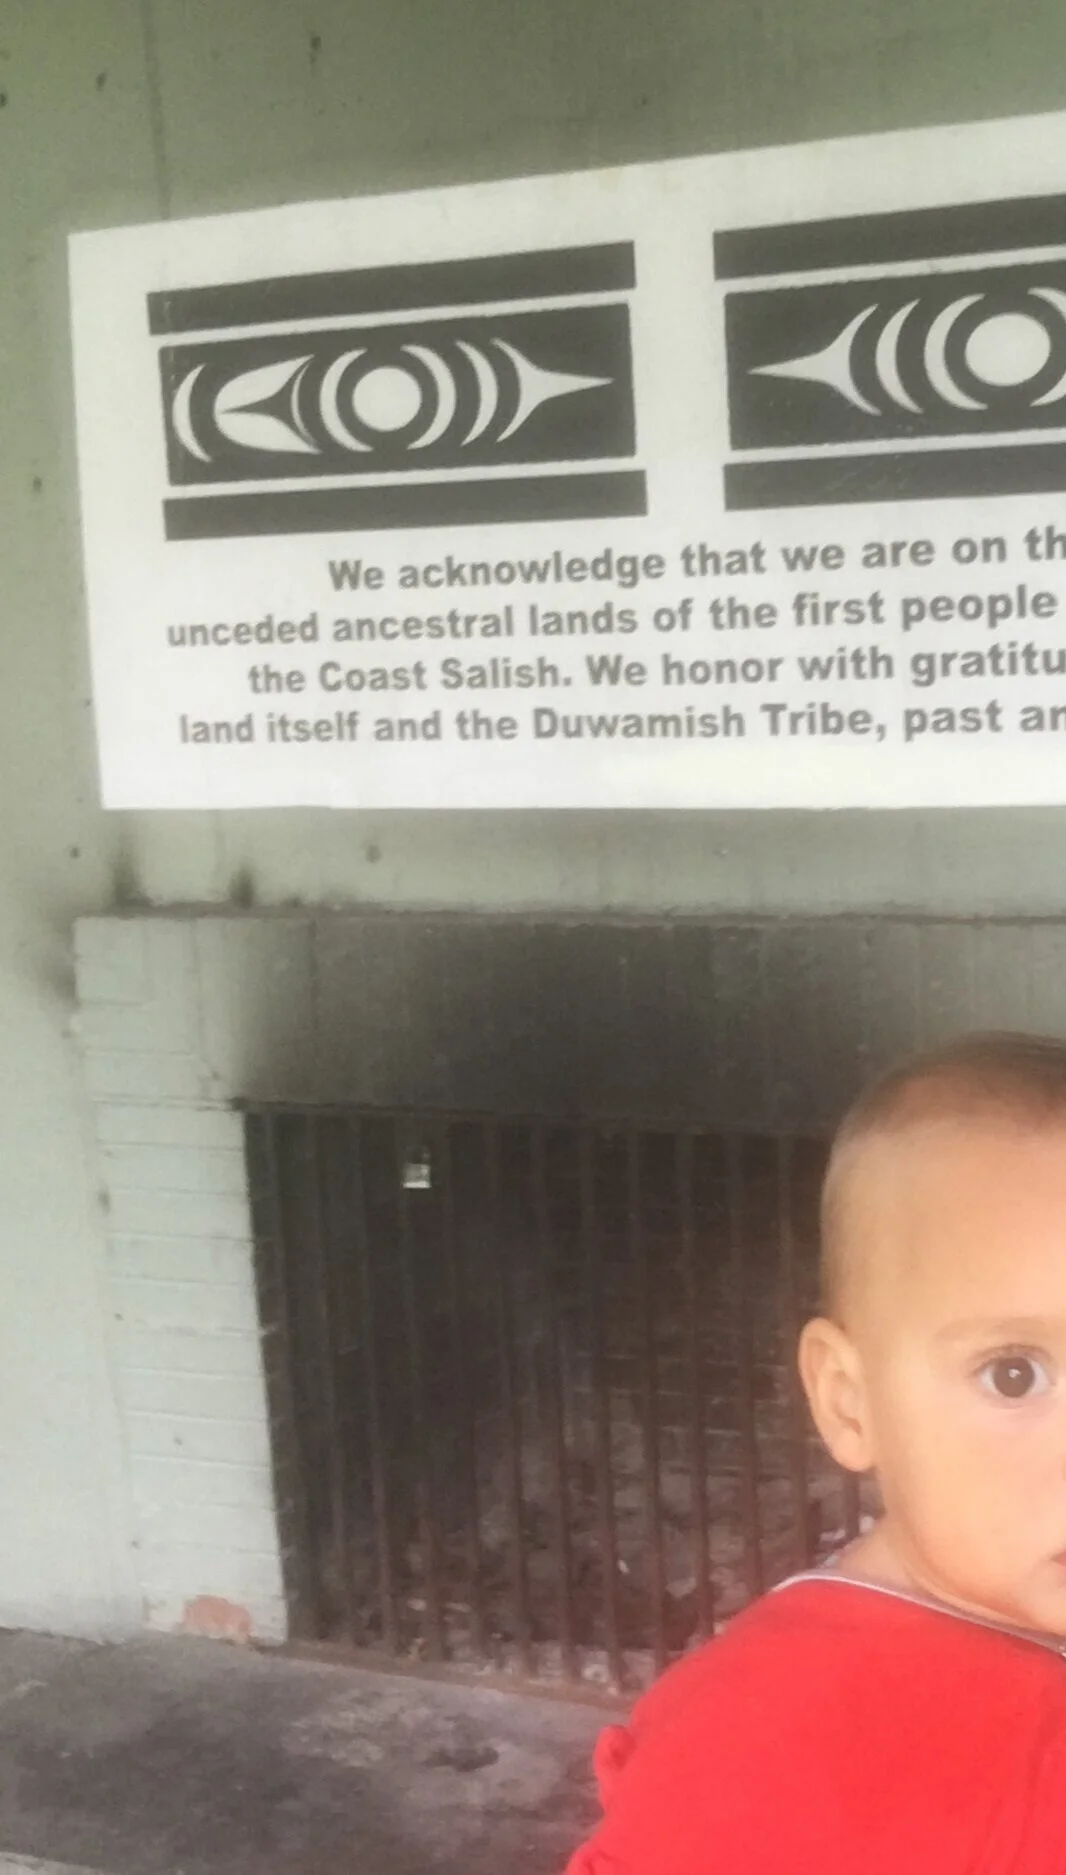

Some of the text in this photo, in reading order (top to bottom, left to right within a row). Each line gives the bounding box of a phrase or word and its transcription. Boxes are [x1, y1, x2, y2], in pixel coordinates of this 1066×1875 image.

[328, 560, 384, 590] We
[399, 548, 665, 588] acknowledge
[681, 542, 766, 576] that
[781, 545, 845, 572] we
[862, 540, 935, 568] are
[952, 537, 1006, 564] on
[169, 612, 318, 646] unceded
[333, 606, 513, 642] ancestral
[530, 602, 637, 636] lands
[654, 598, 693, 632] of
[709, 597, 777, 630] the
[793, 591, 884, 626] first
[902, 584, 1057, 632] people
[249, 665, 305, 693] the
[319, 661, 426, 691] Coast
[441, 657, 571, 689] Salish.
[586, 655, 646, 685] We
[662, 654, 783, 685] honor
[798, 646, 893, 680] with
[181, 714, 253, 742] land
[268, 711, 358, 742] itself
[375, 711, 440, 741] and
[456, 710, 517, 740] the
[534, 705, 744, 738] Duwamish
[761, 703, 885, 740] Tribe,
[904, 700, 1001, 741] past
